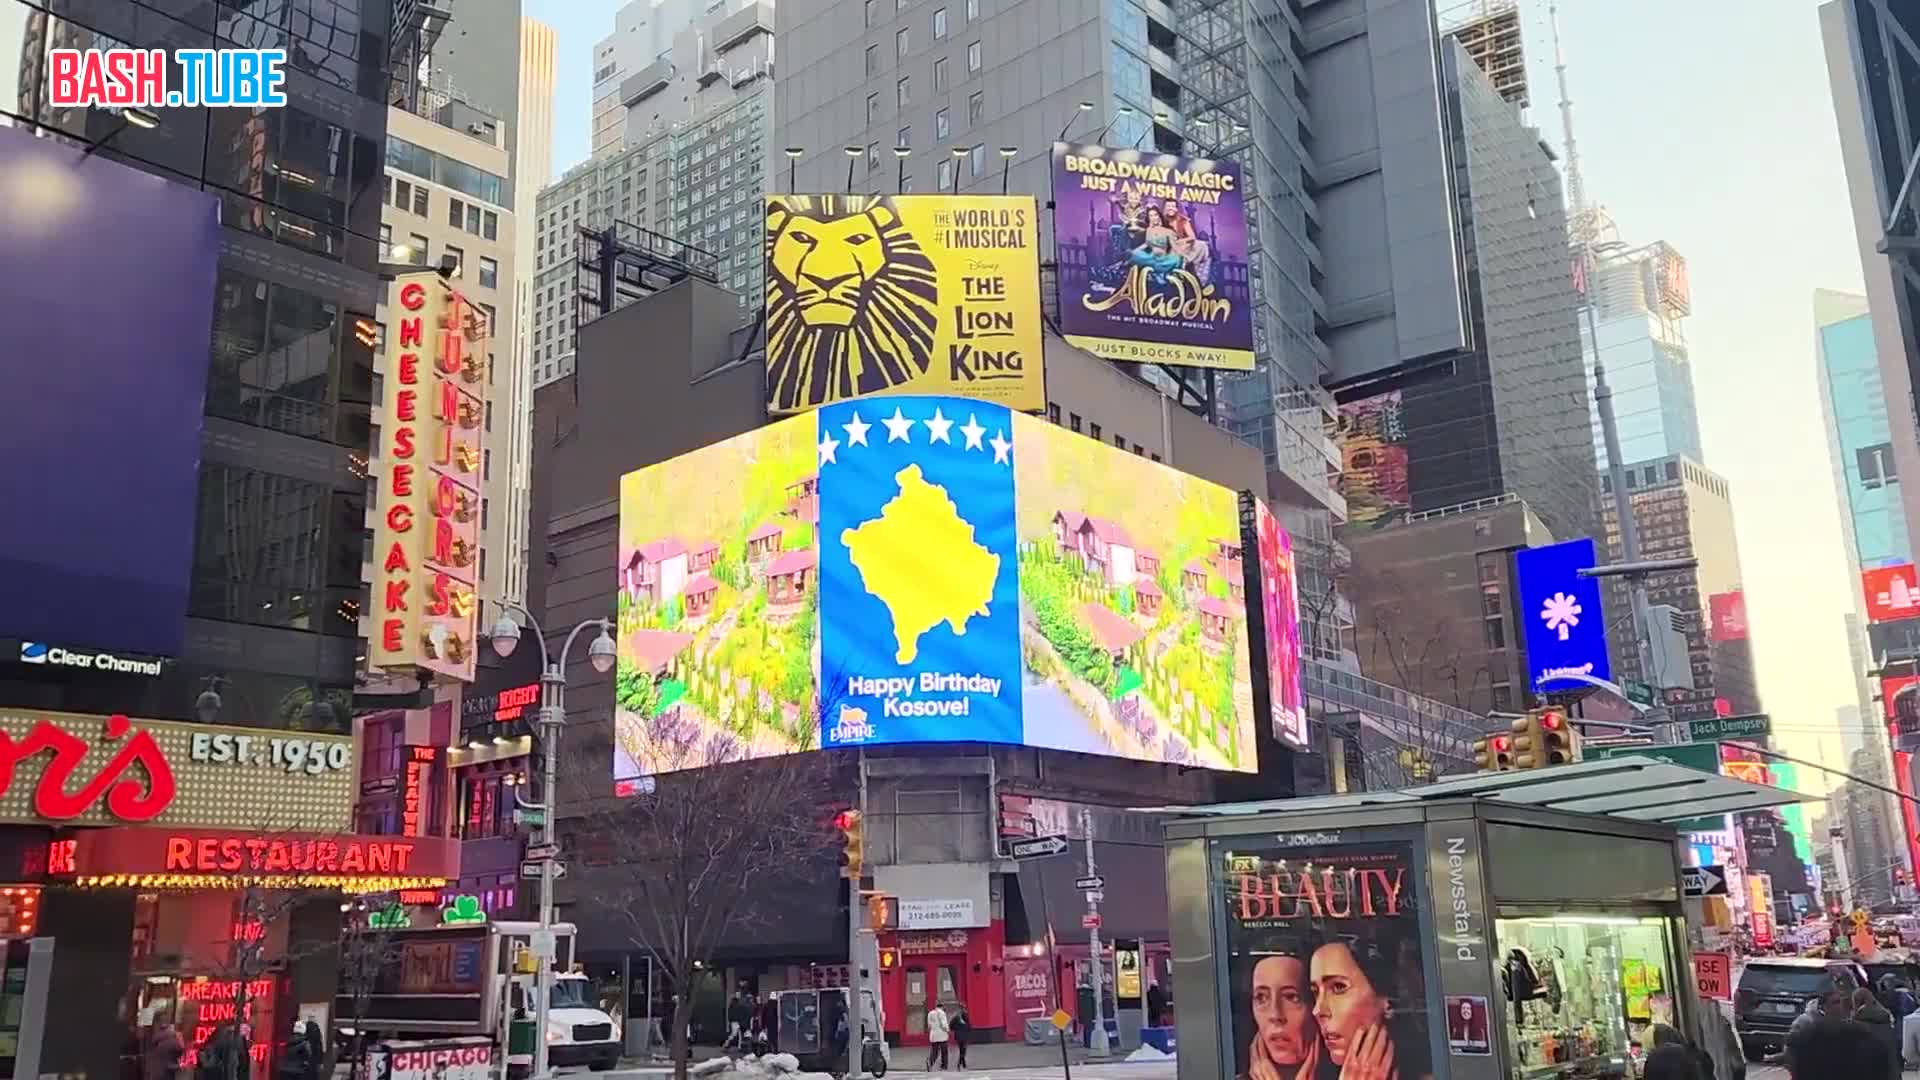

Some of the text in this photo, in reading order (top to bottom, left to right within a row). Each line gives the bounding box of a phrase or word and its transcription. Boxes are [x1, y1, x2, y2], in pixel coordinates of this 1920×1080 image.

[1065, 155, 1234, 190] BROADWAY MAGIC
[1080, 175, 1222, 205] JUST A WISH AWAY
[935, 209, 1025, 227] THE WORLD'S
[954, 229, 1027, 248] MUSICAL
[961, 277, 1005, 295] THE
[1082, 265, 1232, 323] Aladdin
[955, 305, 1013, 339] LION
[1139, 318, 1179, 327] BROADWAY
[1182, 322, 1214, 330] MUSICAL
[949, 344, 1023, 382] KING
[1095, 343, 1227, 363] JUST BLOCKS AWAY!
[383, 284, 425, 652] CHEESECAKE
[48, 648, 161, 676] Clear Channel
[849, 671, 1001, 698] Happy Birthday
[883, 697, 969, 718] Kosove!
[830, 724, 877, 741] EMPIRE
[1693, 716, 1768, 734] Jack Dempsey
[191, 733, 349, 775] EST. 1950
[414, 747, 435, 760] THE
[166, 836, 415, 872] RESTAURANT
[1015, 846, 1032, 856] ONE
[1682, 874, 1709, 890] WAY
[1234, 867, 1406, 919] BEAUTY
[1697, 960, 1720, 973] ISE
[1015, 973, 1046, 990] TACOS
[1699, 979, 1720, 992] OW
